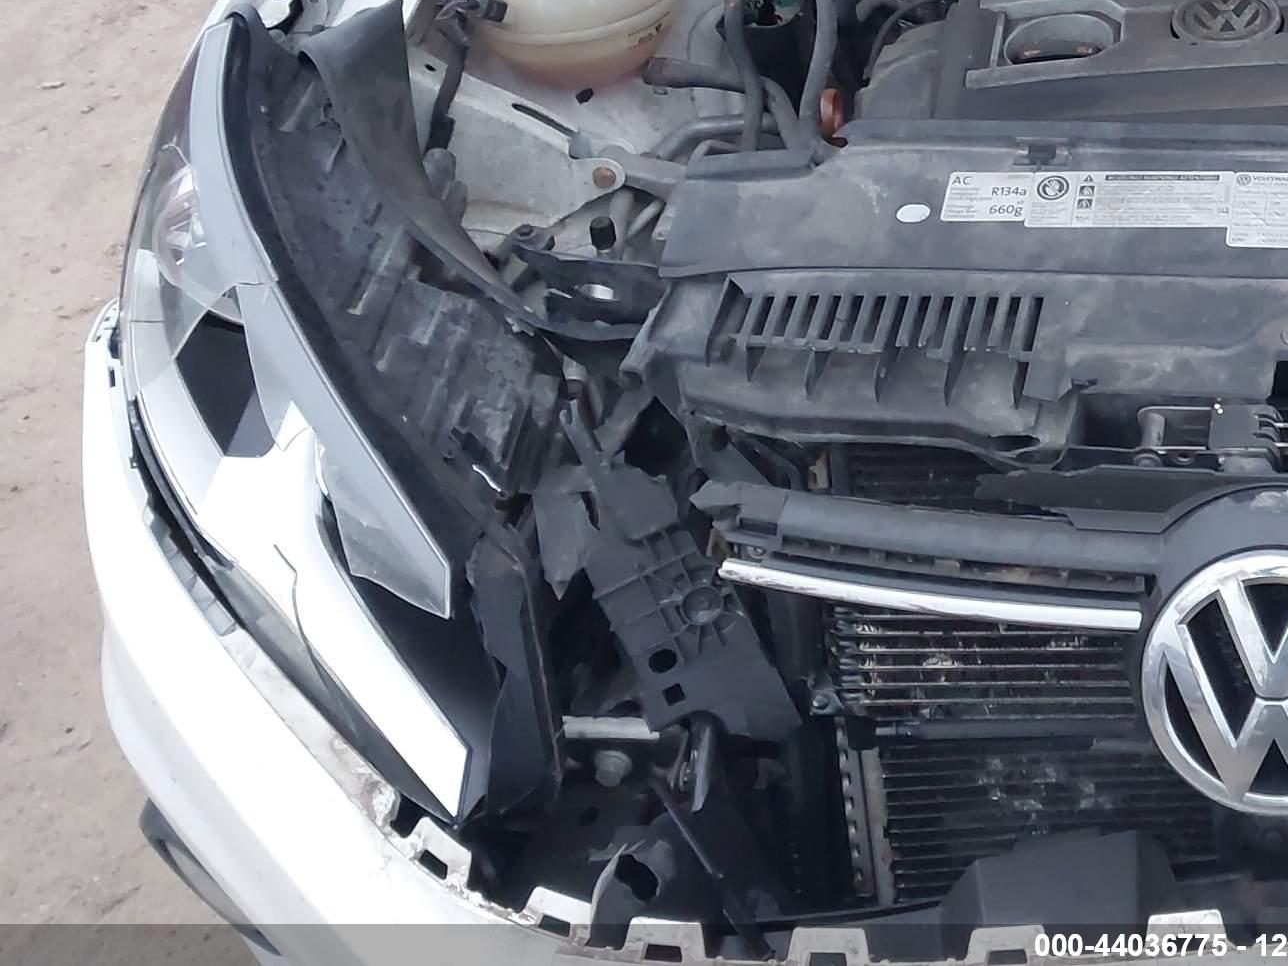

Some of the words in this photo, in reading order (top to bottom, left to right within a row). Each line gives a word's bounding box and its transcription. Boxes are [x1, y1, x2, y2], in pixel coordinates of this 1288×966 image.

[951, 176, 972, 185] AC
[991, 186, 1027, 196] R134a
[988, 204, 1023, 217] 660g
